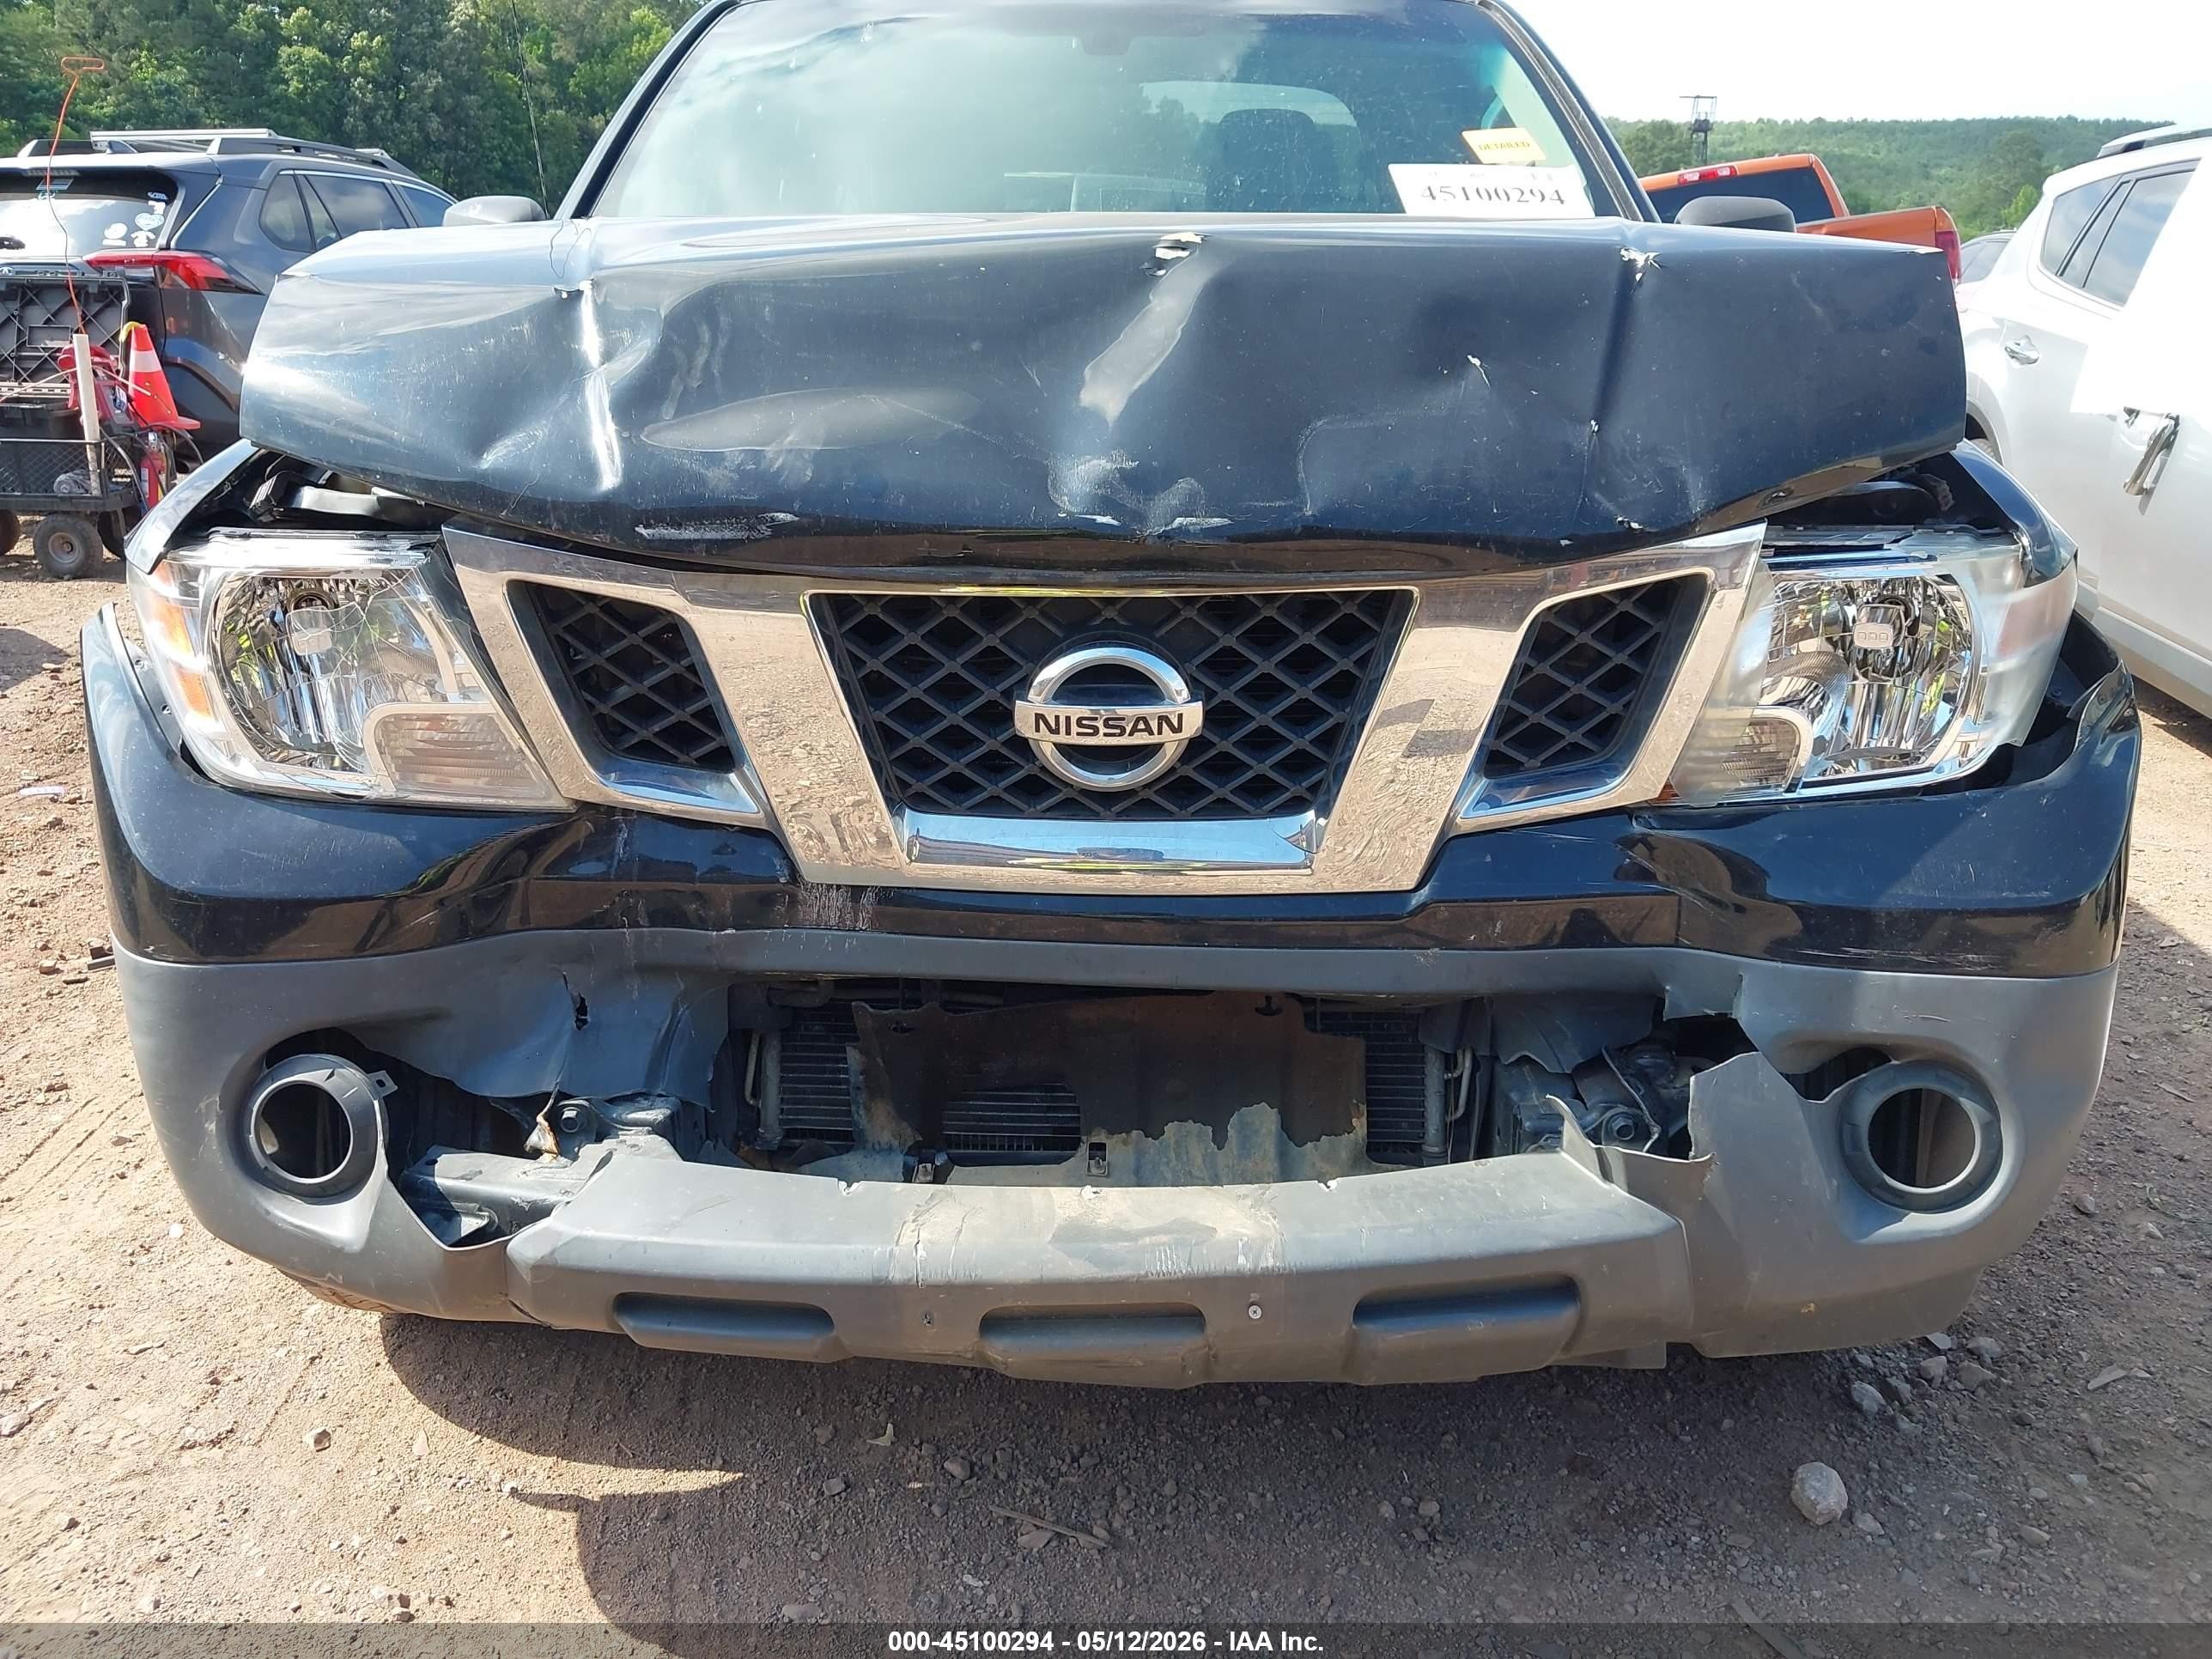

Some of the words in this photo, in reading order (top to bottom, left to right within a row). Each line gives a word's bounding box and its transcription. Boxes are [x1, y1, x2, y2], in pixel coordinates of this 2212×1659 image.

[1479, 141, 1530, 151] DETAILED
[1421, 185, 1565, 204] 45100294
[1034, 712, 1183, 737] NISSAN
